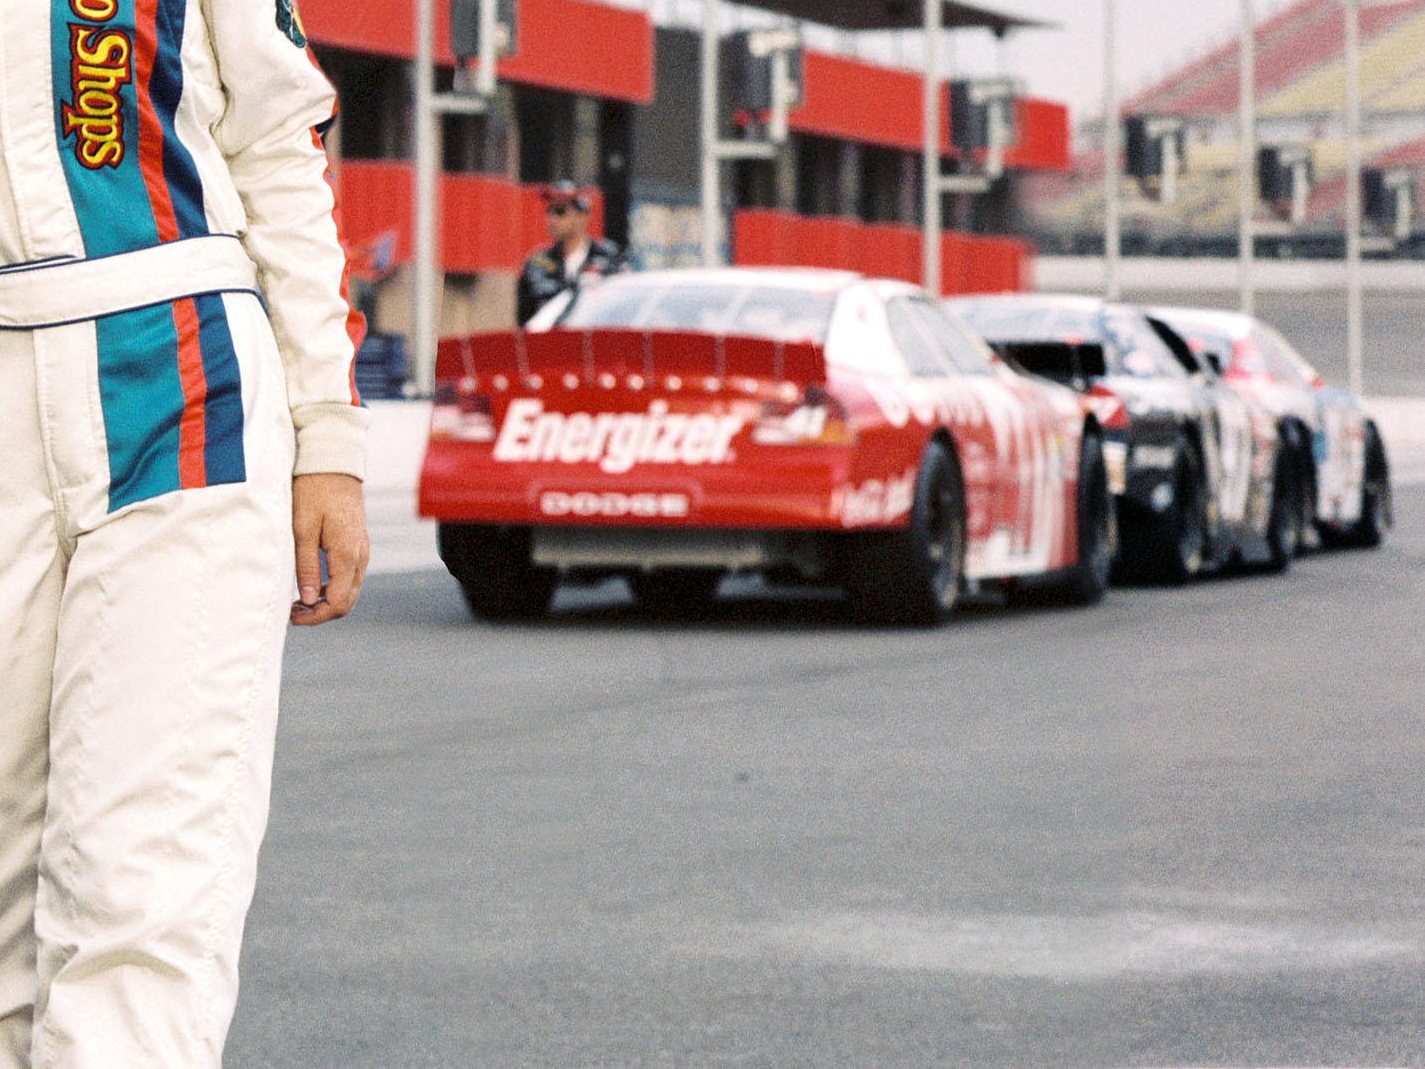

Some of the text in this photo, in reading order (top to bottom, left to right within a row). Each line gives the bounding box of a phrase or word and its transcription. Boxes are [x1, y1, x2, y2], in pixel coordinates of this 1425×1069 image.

[61, 22, 132, 170] Shops
[492, 397, 747, 474] Energizer
[539, 491, 689, 518] DODGE
